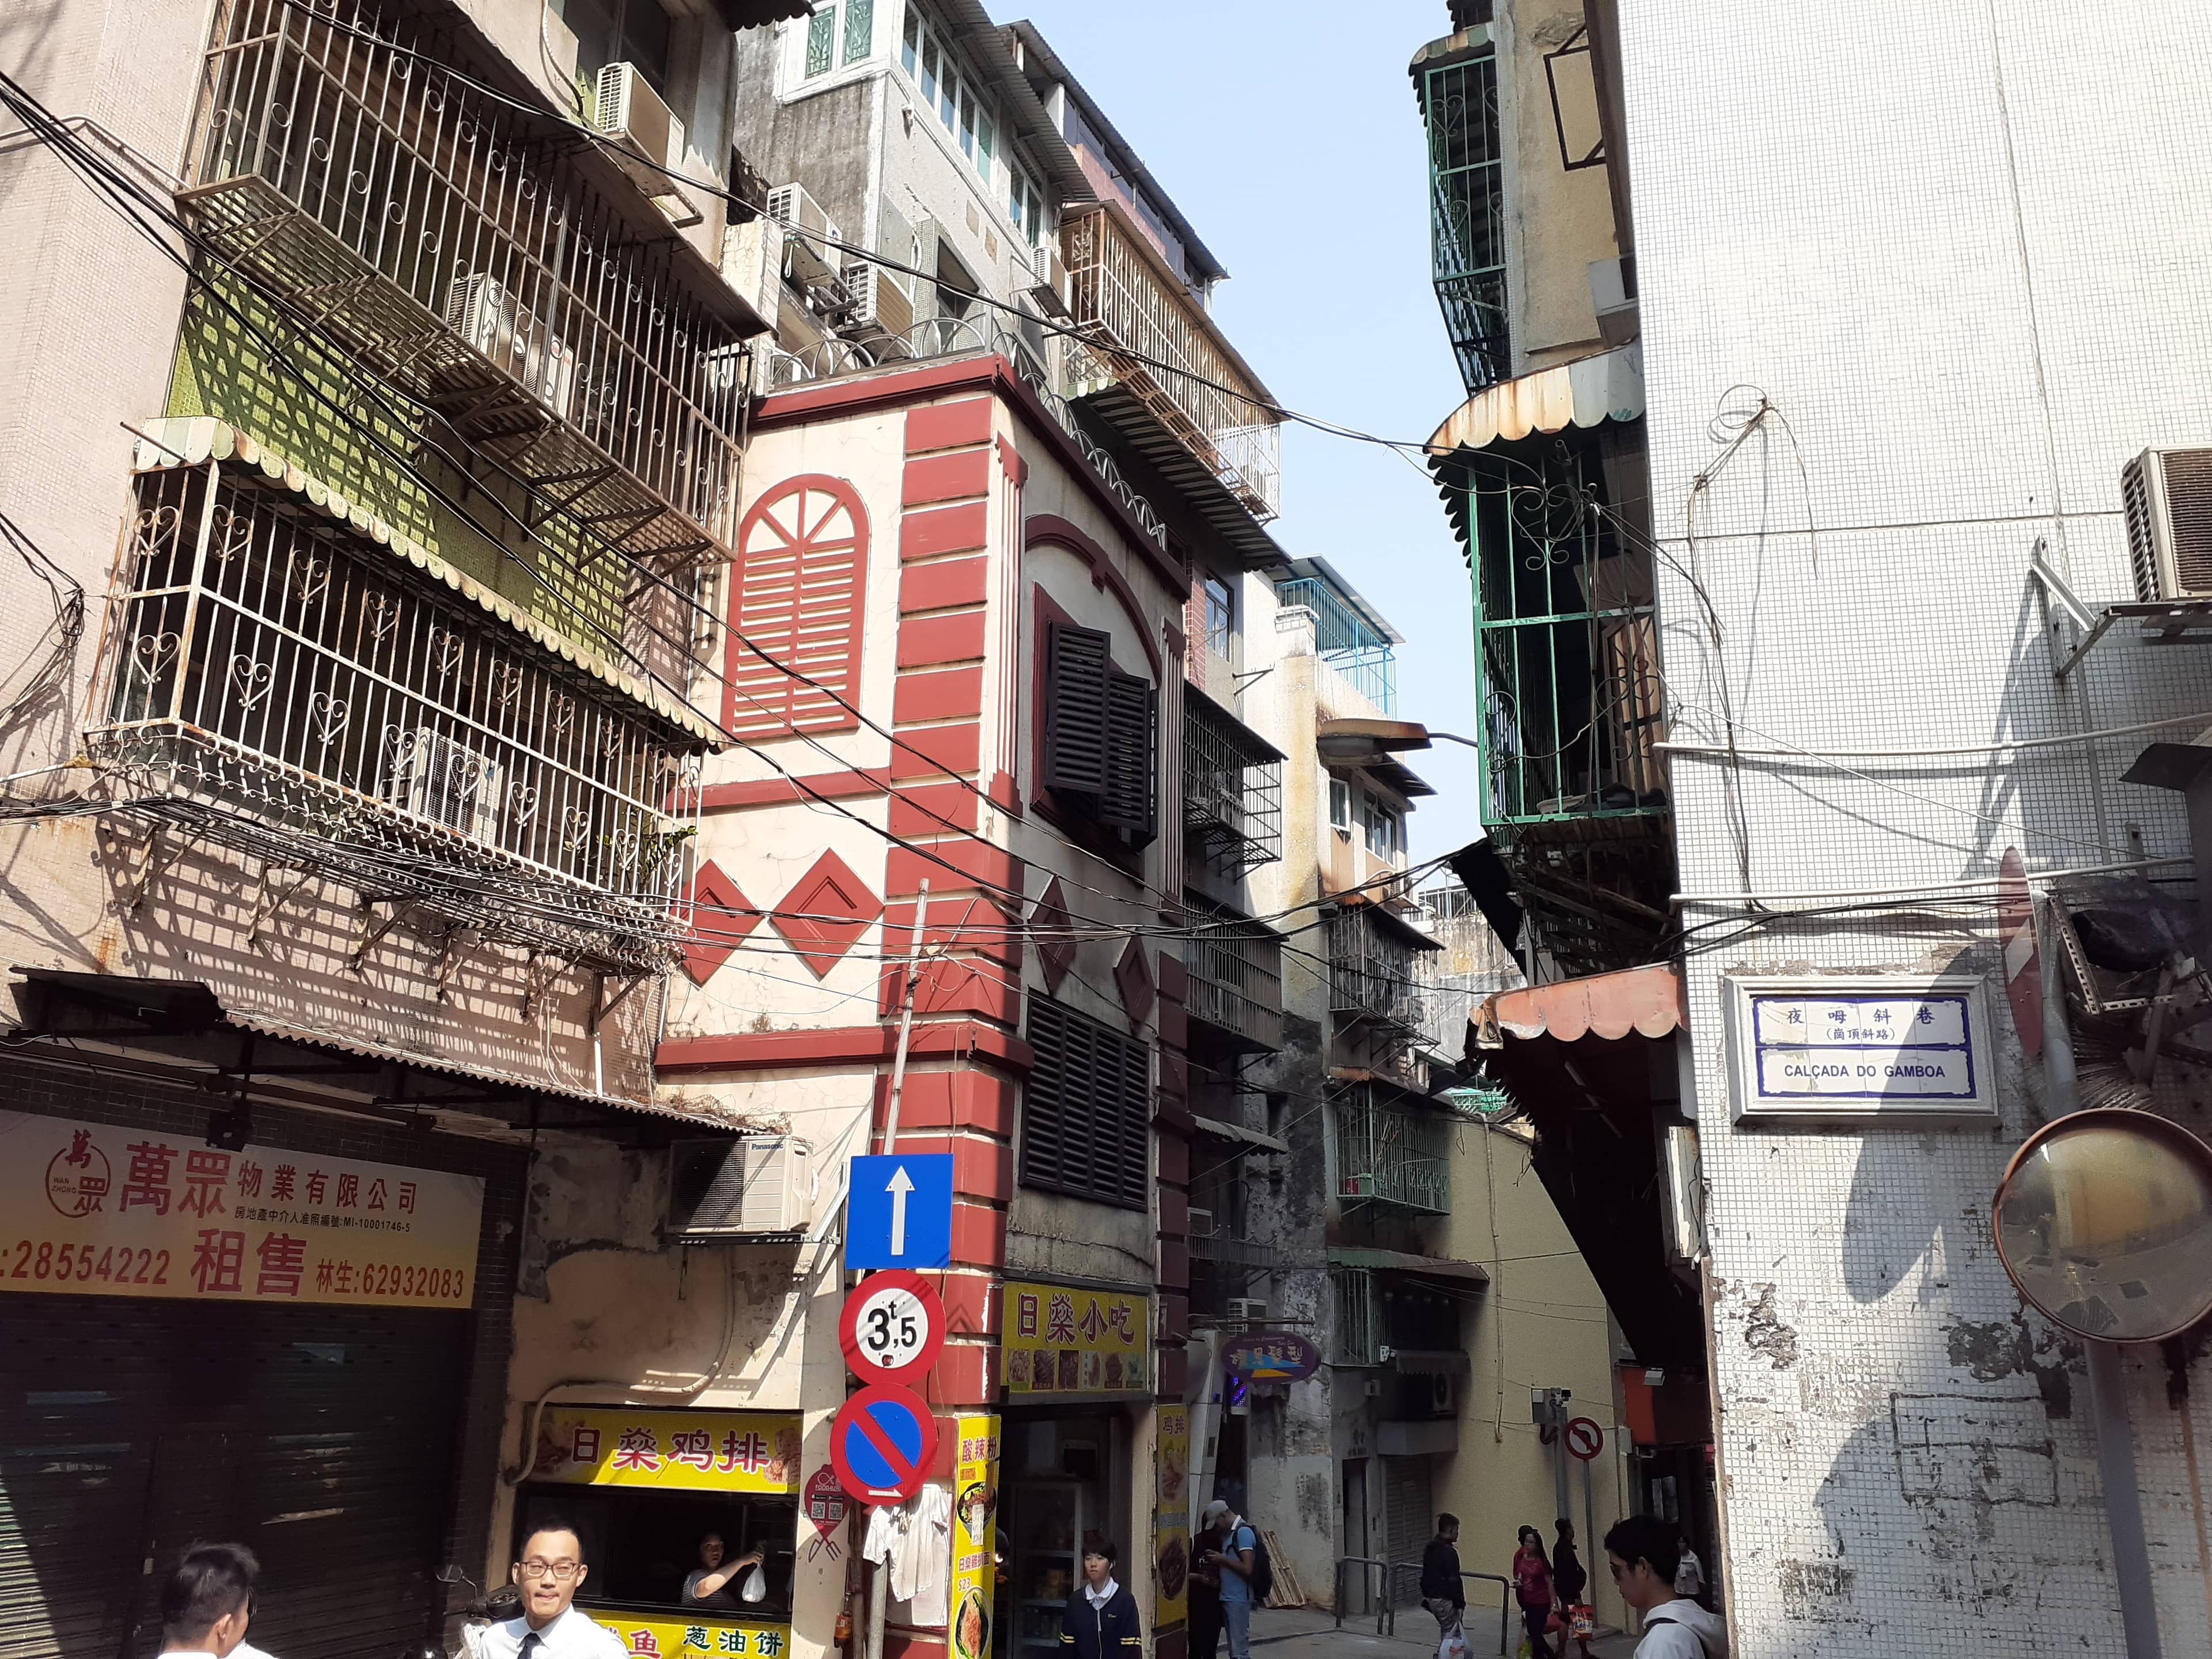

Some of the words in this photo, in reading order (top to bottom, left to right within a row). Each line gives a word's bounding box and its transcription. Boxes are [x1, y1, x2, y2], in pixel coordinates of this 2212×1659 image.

[1786, 1007, 1936, 1025] 夜呣斜巷
[1784, 1065, 1850, 1081] CALÇADA
[1857, 1065, 1876, 1077] DO
[1884, 1065, 1946, 1078] GAMBOA
[51, 1185, 77, 1194] ZHONG
[190, 1228, 308, 1297] 租售
[1162, 1414, 1185, 1435] 鸡排
[961, 1435, 998, 1464] 酸辣粉
[682, 1626, 784, 1657] 葱油饼
